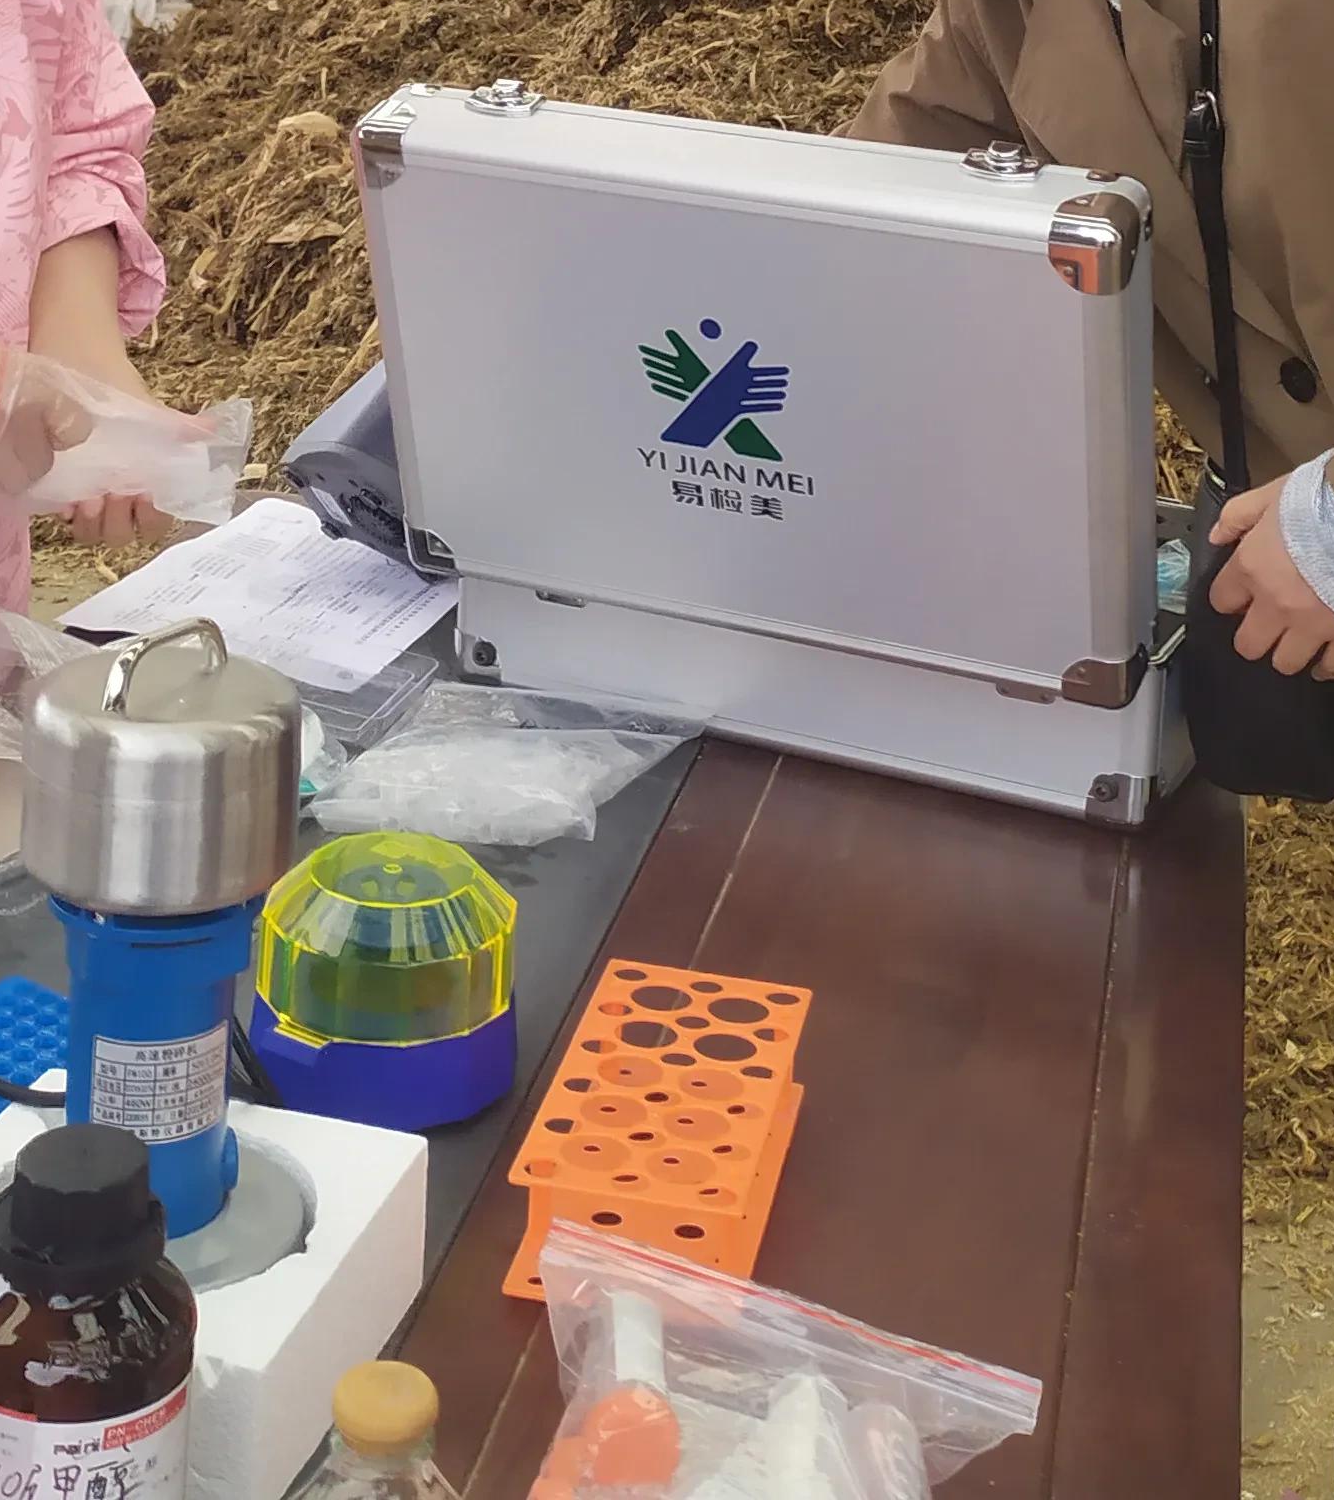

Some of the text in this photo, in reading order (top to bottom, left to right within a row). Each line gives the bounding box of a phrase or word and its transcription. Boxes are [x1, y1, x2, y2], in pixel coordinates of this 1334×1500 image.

[637, 447, 815, 496] YI JIAN MEI
[671, 480, 784, 521] 易检美
